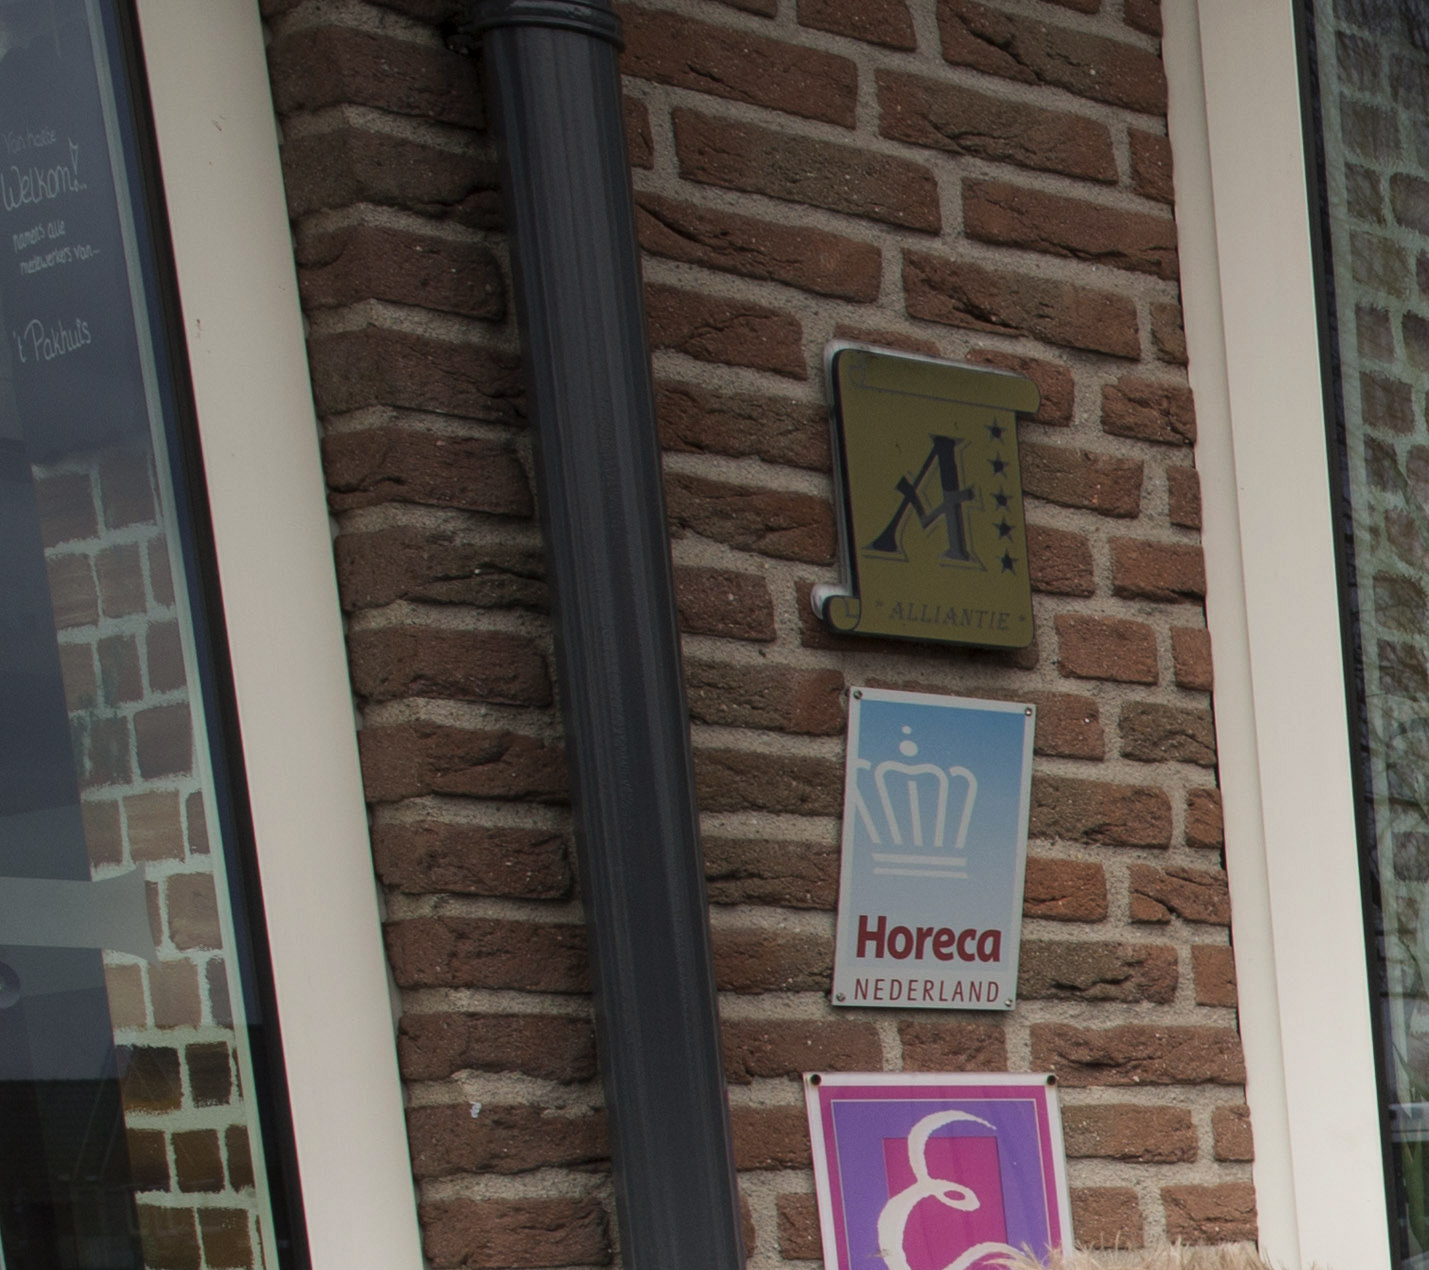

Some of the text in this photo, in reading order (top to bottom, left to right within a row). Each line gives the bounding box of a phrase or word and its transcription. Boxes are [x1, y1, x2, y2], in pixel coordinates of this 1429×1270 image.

[25, 318, 91, 361] Pakhuis
[888, 600, 1012, 631] ALLIANTIE
[855, 914, 1002, 963] Horeca
[853, 977, 1000, 1003] NEDERLAND
